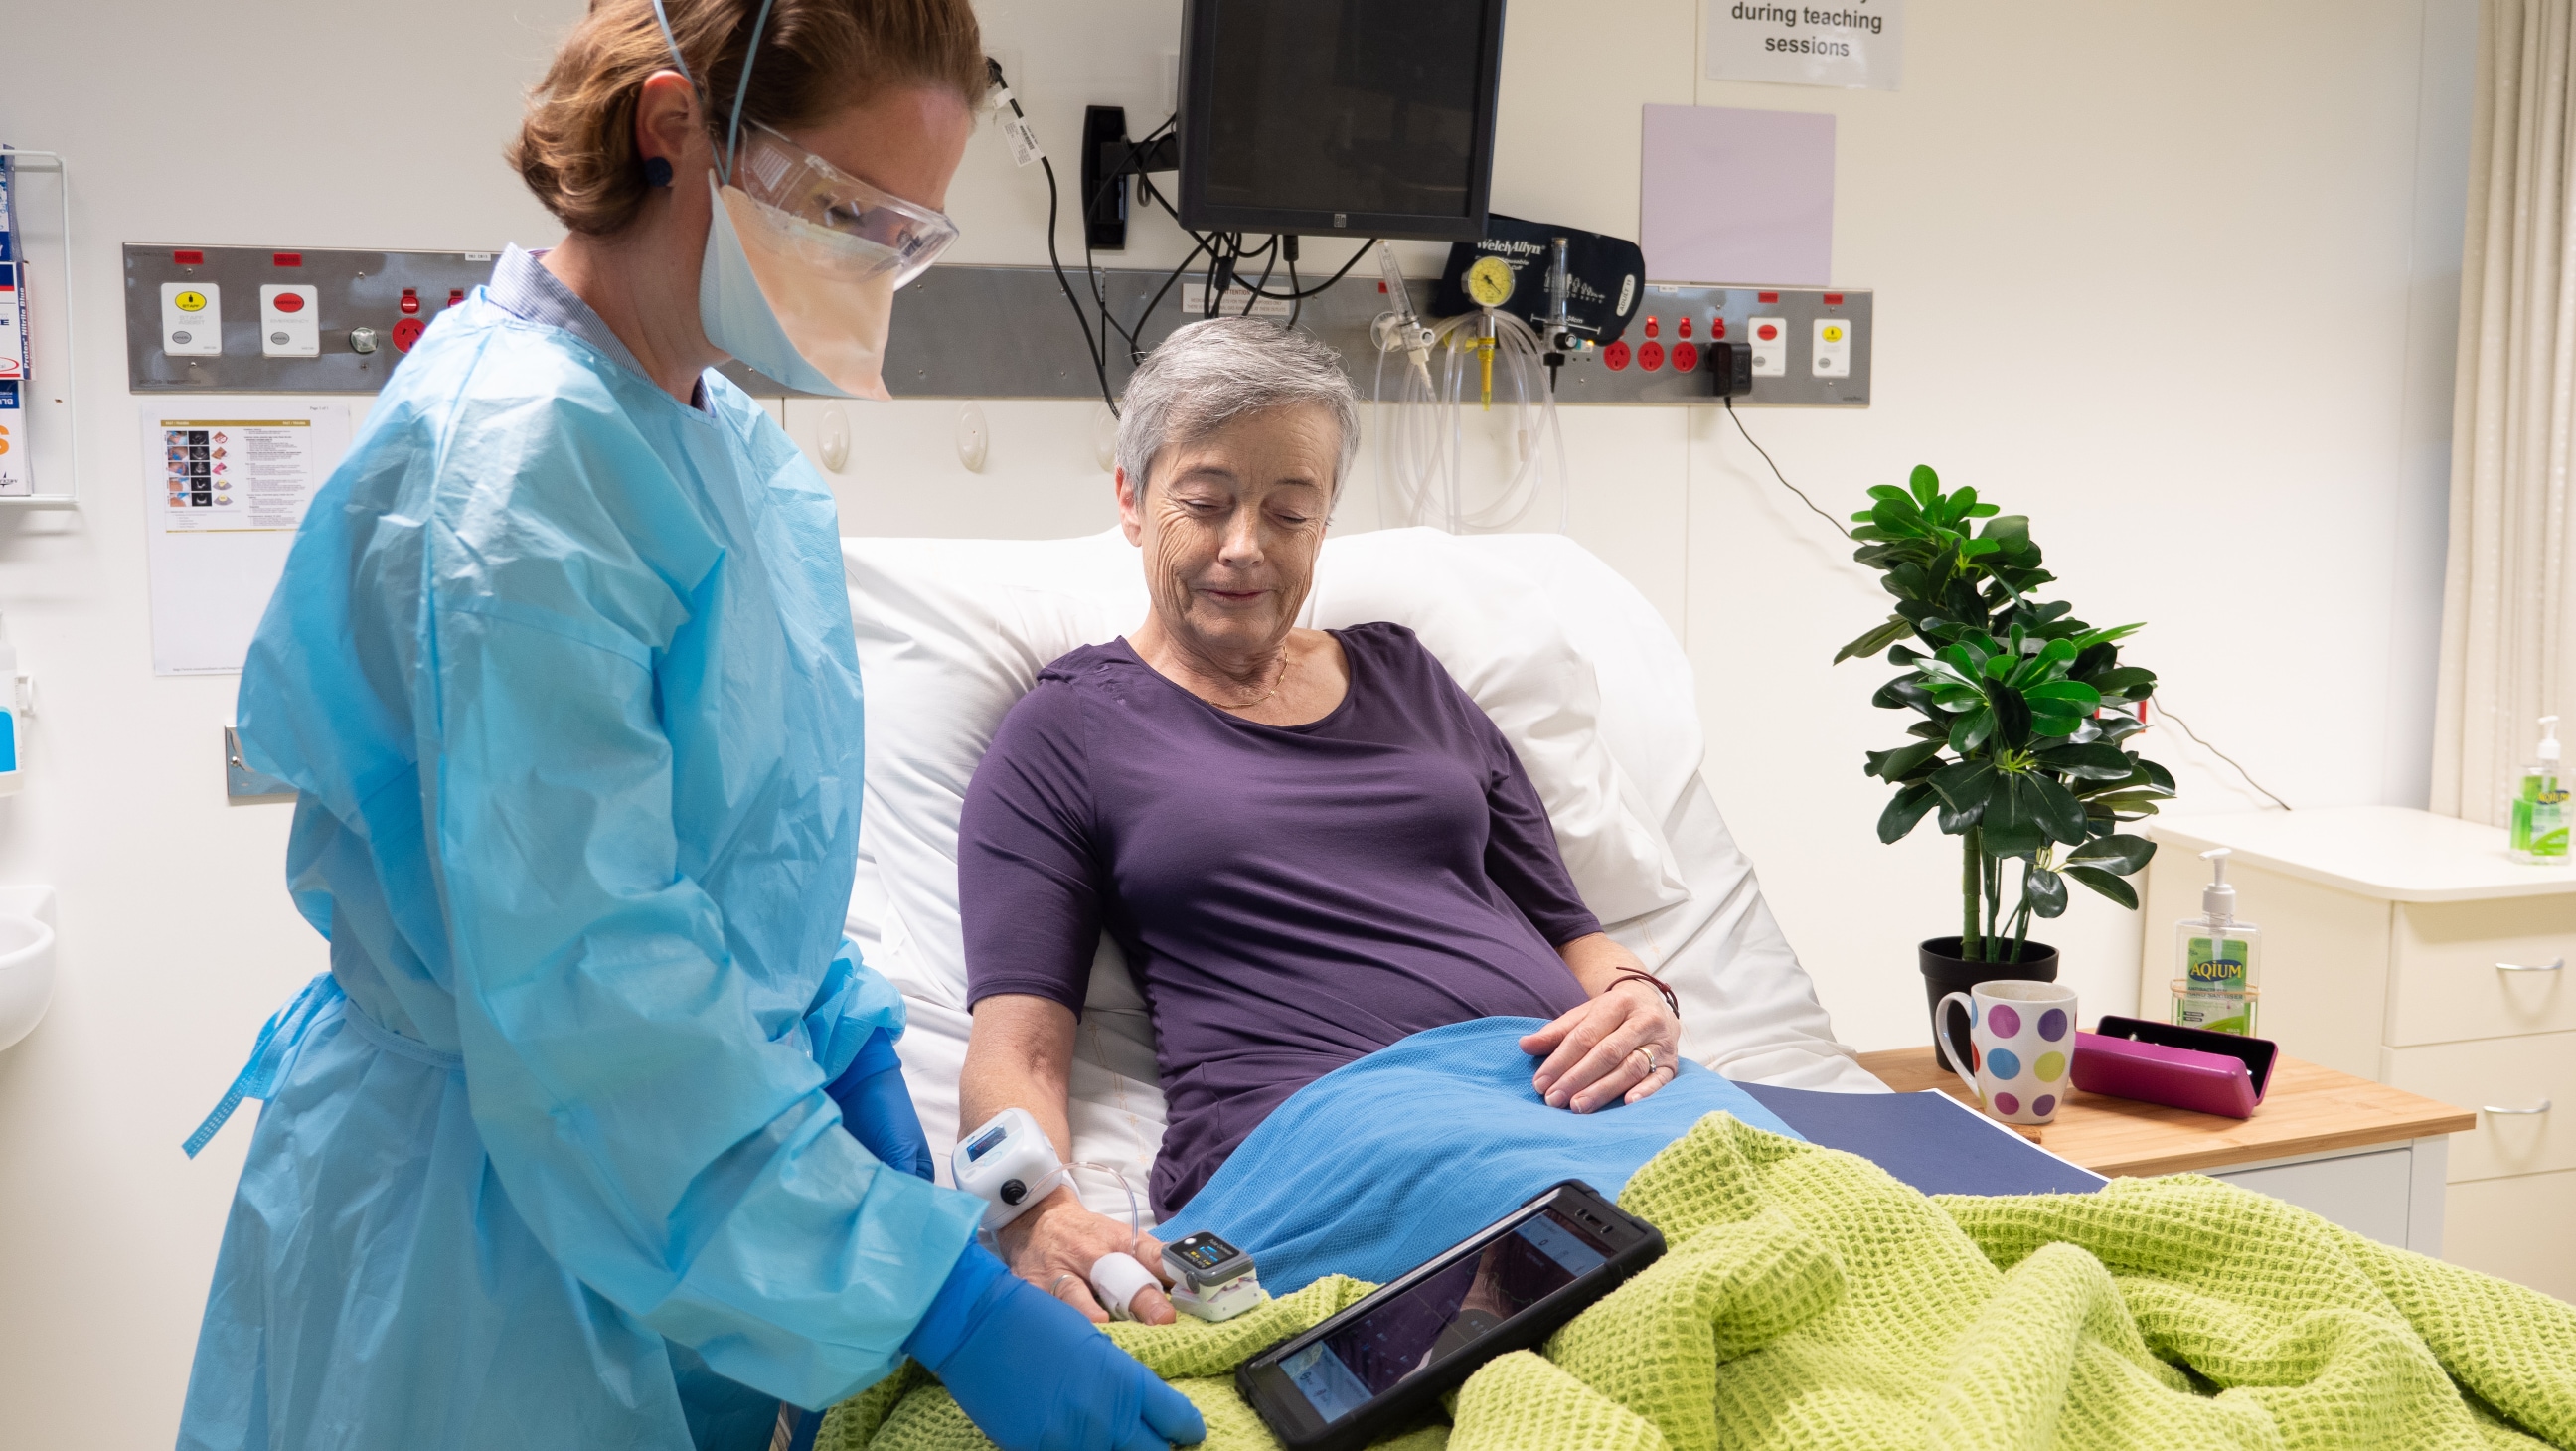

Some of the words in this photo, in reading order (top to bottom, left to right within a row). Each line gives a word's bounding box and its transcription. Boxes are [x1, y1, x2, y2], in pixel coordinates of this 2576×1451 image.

[1731, 2, 1797, 28] during
[1803, 7, 1882, 34] teaching
[1765, 36, 1850, 57] sessions
[1620, 287, 1631, 311] ADULT
[2190, 961, 2242, 980] AQIUM
